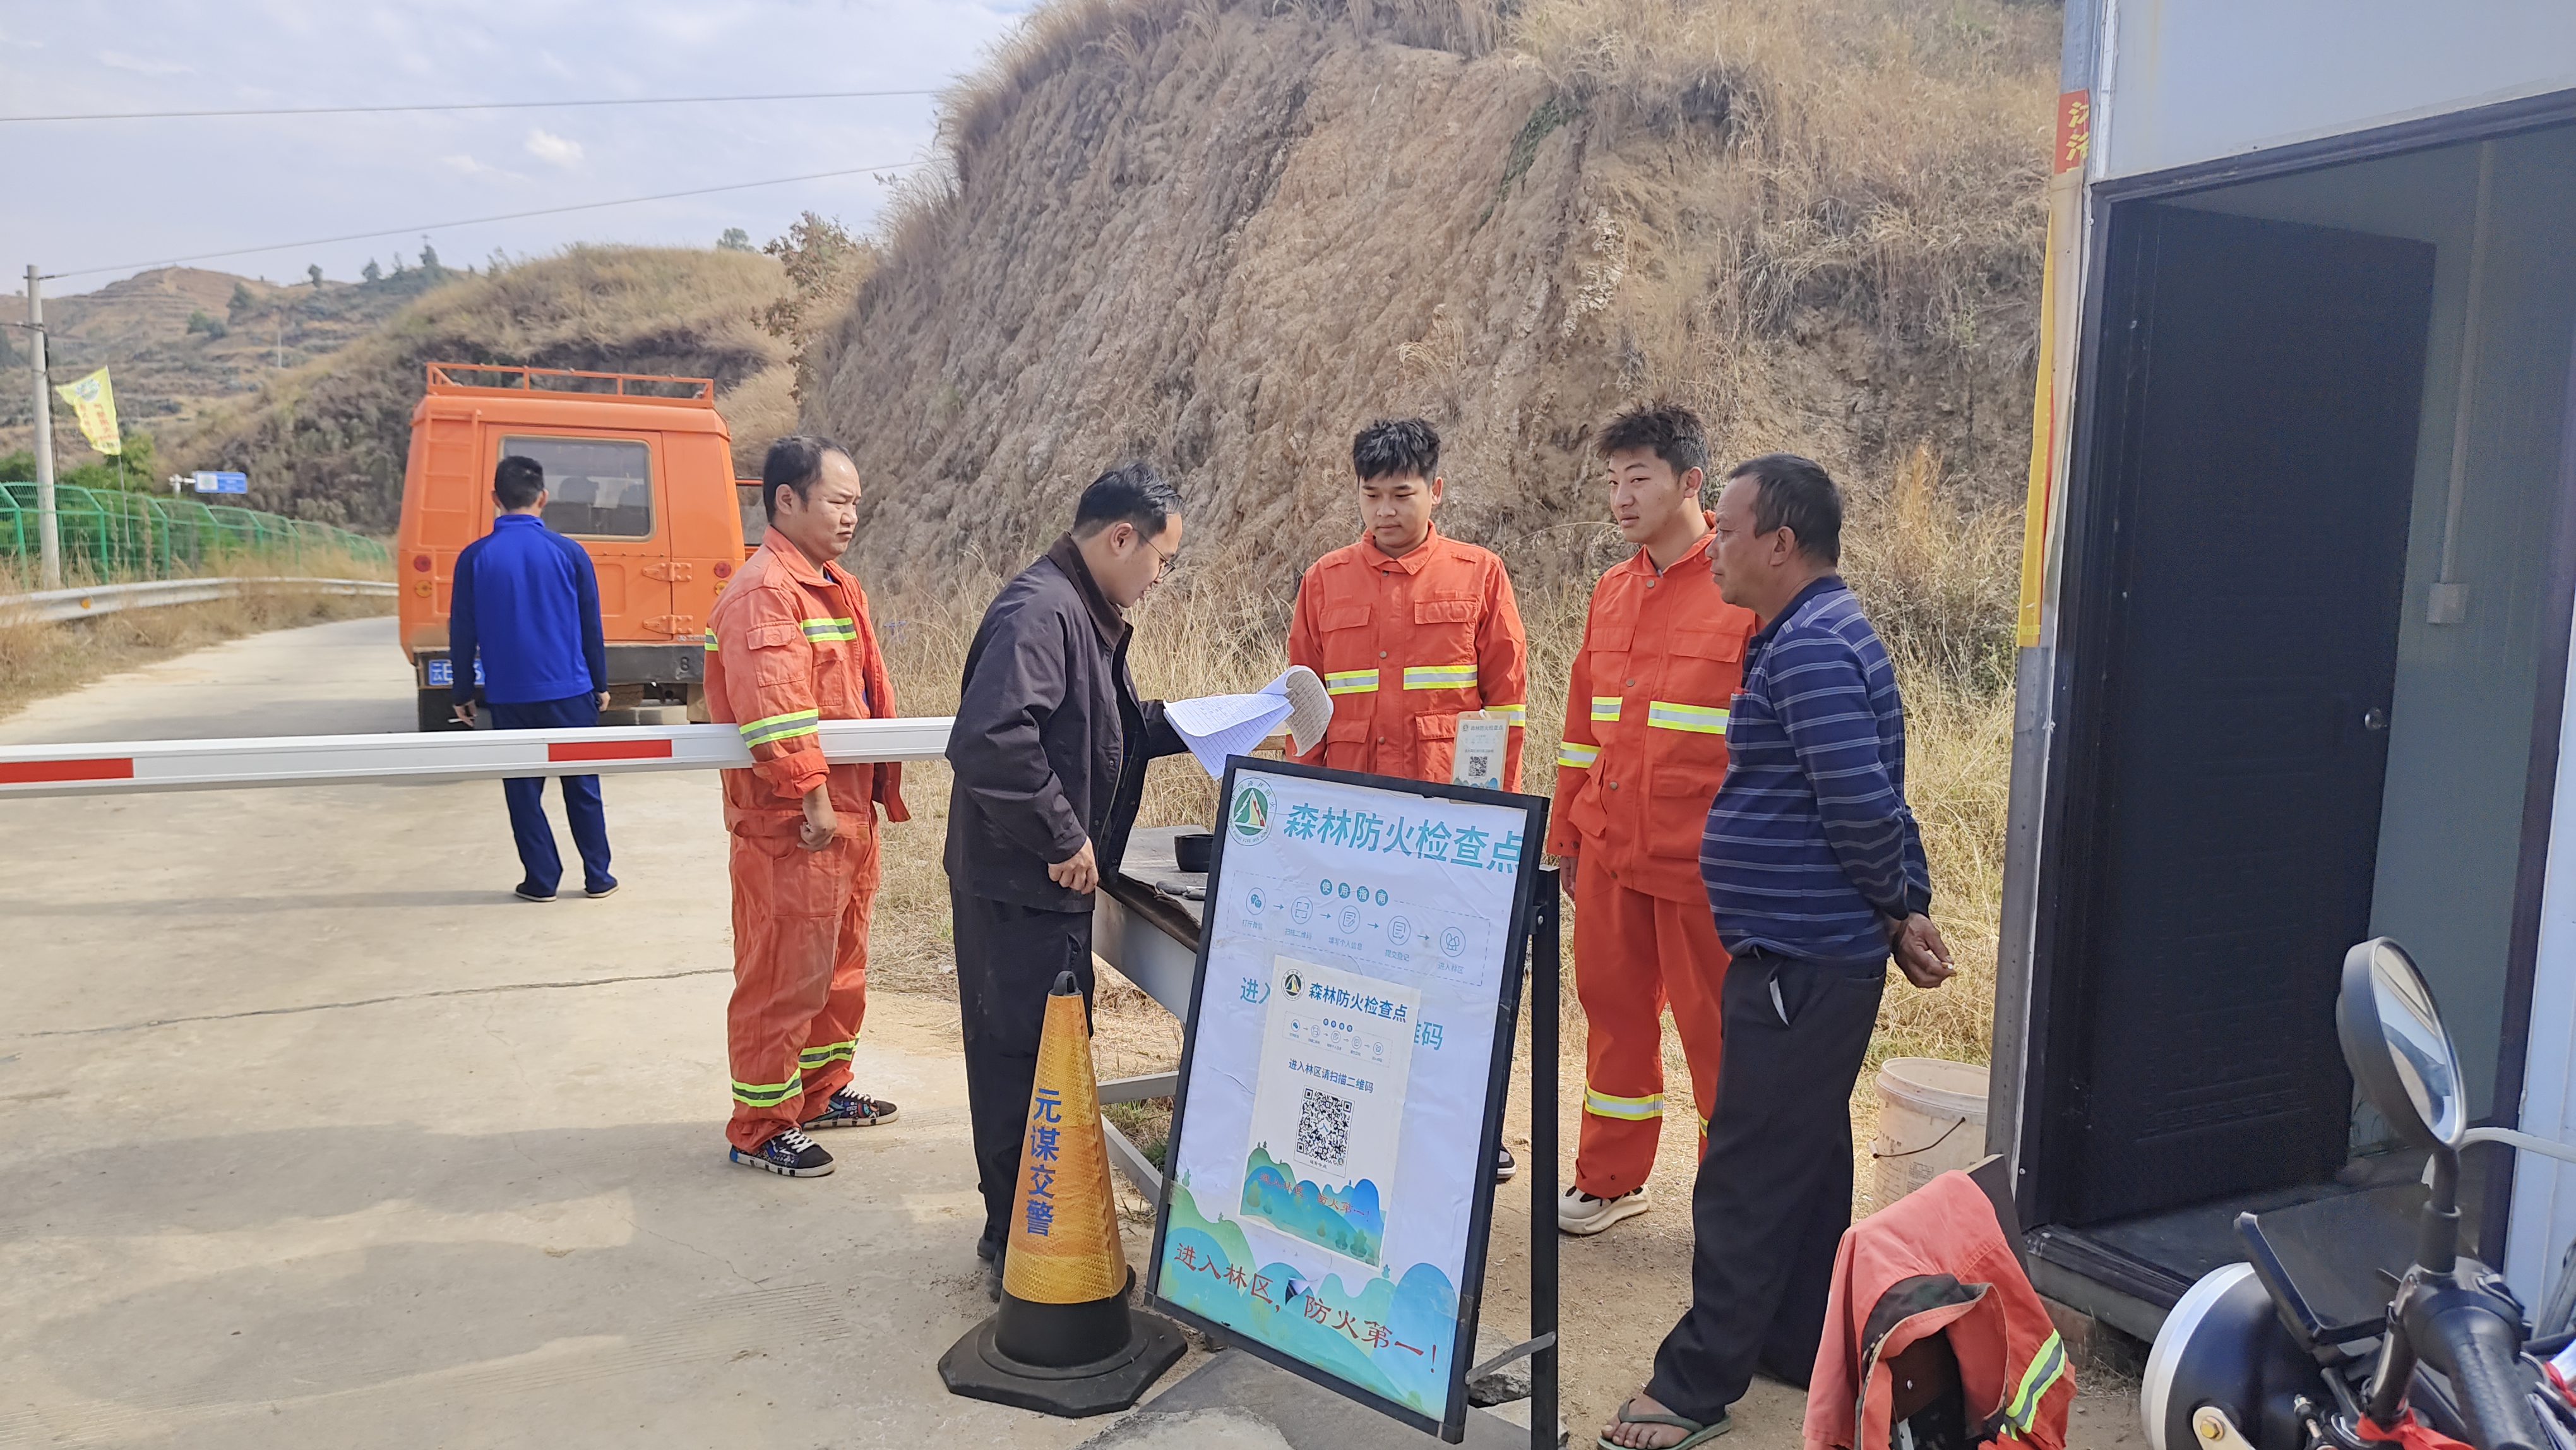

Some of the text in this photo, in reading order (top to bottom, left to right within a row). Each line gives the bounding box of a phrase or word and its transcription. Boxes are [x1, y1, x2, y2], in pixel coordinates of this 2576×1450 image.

[1283, 803, 1524, 874] 森林防火检查点
[1321, 879, 1388, 906] 使用指南
[1385, 949, 1410, 962] 提交登记
[1438, 962, 1464, 974] 进入林区
[1308, 982, 1408, 1023] 森林防火检查点
[1288, 1058, 1374, 1094] 进入林区请扫描二维码
[1025, 1088, 1062, 1237] 元谋交警
